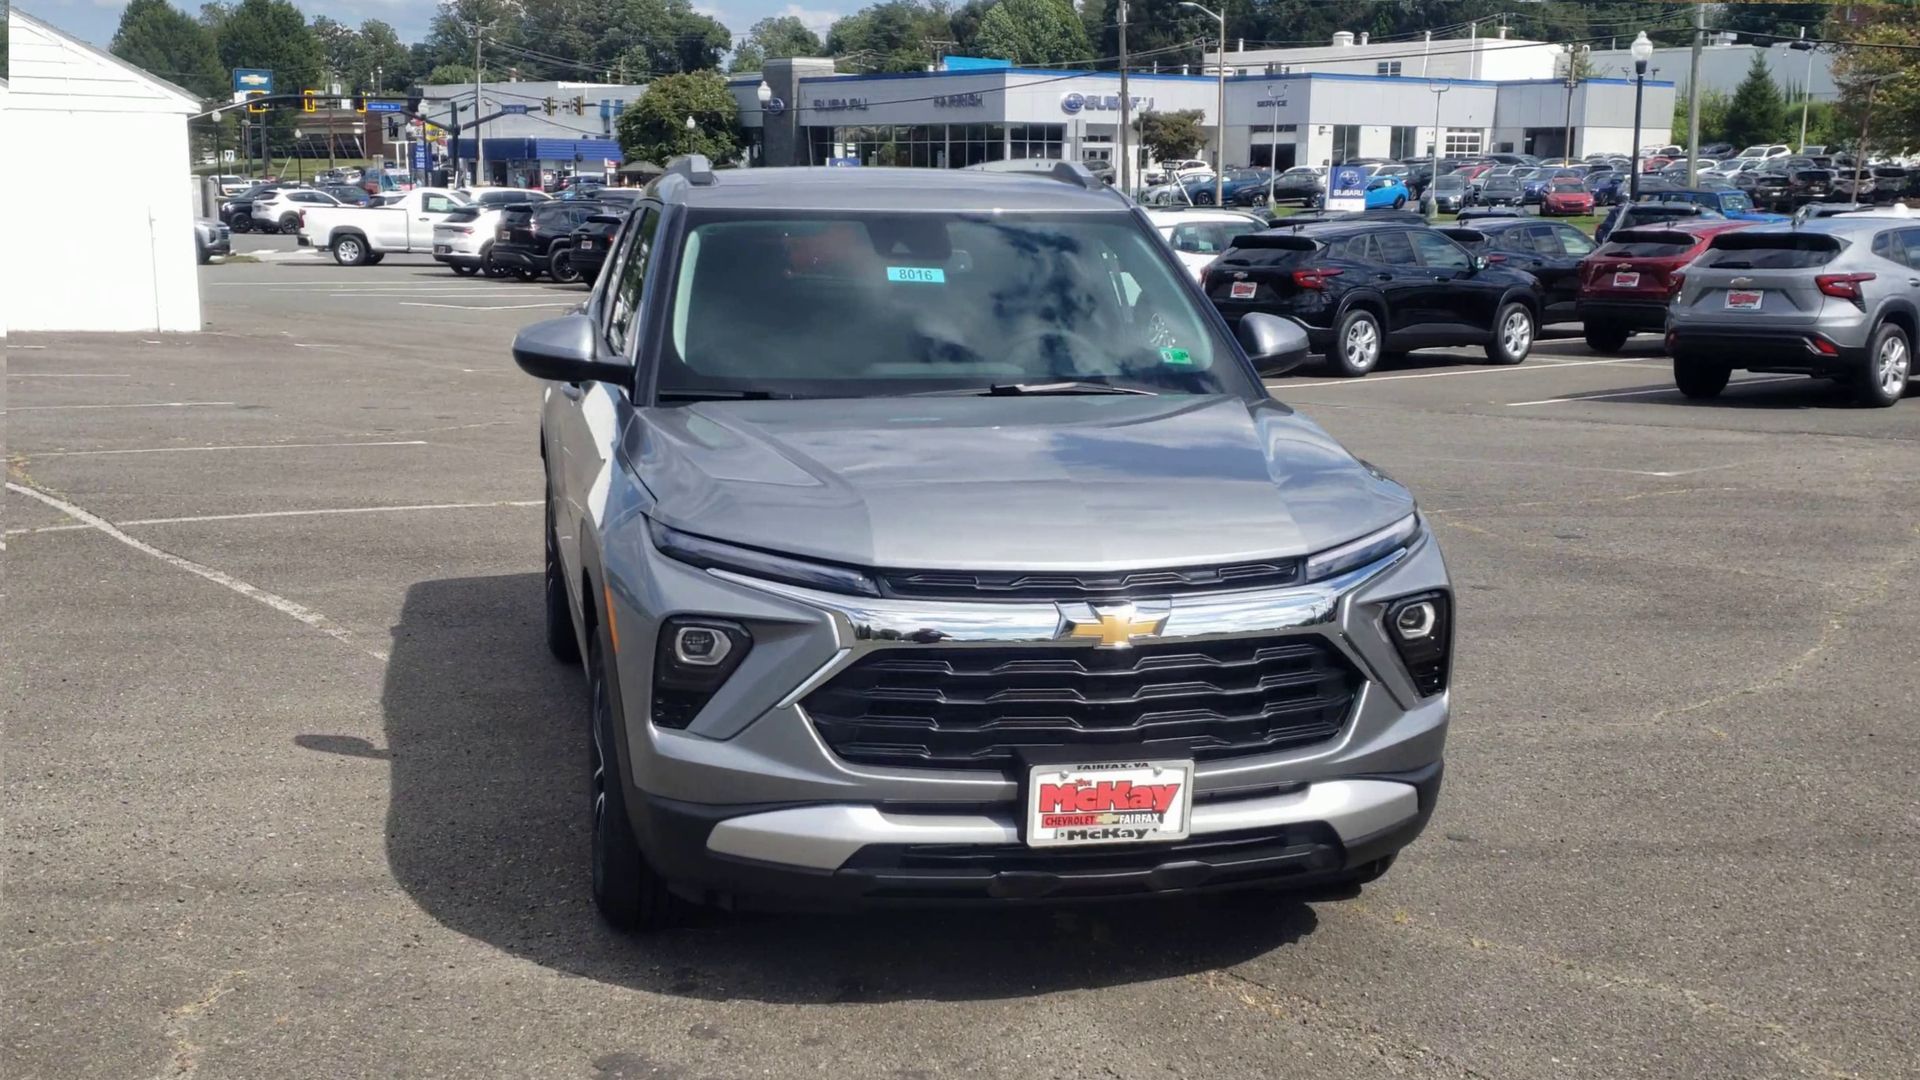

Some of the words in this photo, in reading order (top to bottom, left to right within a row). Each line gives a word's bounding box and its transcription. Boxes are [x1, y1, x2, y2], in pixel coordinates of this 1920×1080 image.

[1333, 189, 1364, 197] SUBARU
[899, 269, 933, 280] 8016
[1039, 780, 1181, 813] McKay
[1045, 815, 1096, 826] CHEVROLET
[1119, 813, 1160, 825] FAIRFAX
[1067, 828, 1150, 841] McKay
